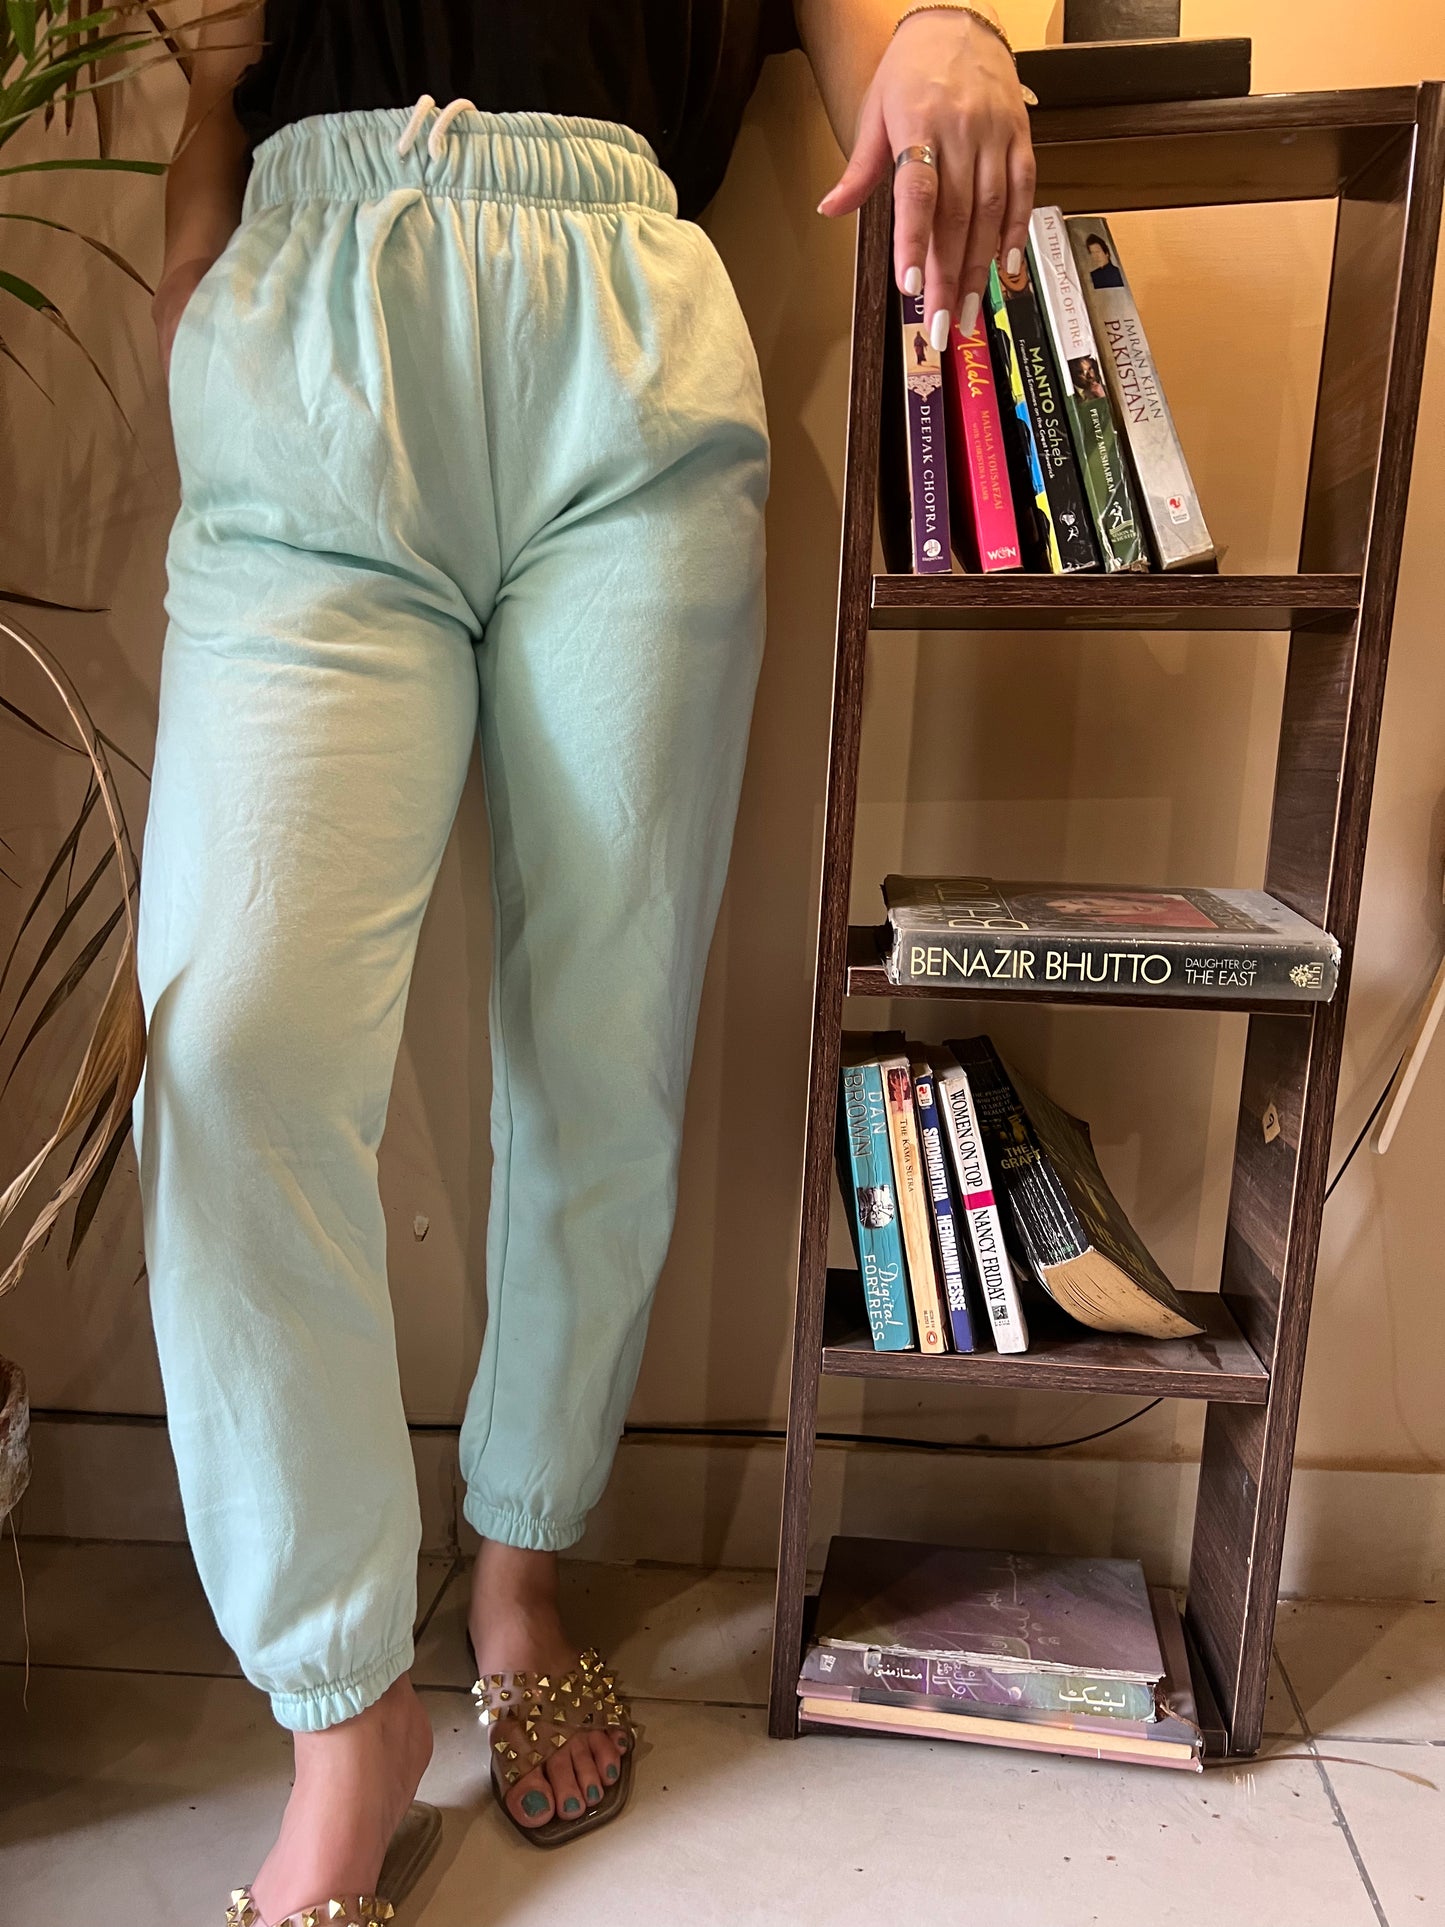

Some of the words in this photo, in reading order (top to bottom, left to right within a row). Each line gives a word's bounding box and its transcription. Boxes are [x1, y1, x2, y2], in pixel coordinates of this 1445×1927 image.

[1044, 216, 1056, 230] IN
[1048, 233, 1062, 261] THE
[1055, 261, 1071, 294] LINE
[1063, 297, 1076, 317] OF
[1068, 317, 1083, 348] FIRE
[1019, 339, 1029, 364] Friends
[1025, 364, 1033, 378] and
[1104, 319, 1150, 424] PAKISTAN
[1123, 318, 1149, 370] IMRAN
[1140, 375, 1165, 419] KHAN
[1027, 378, 1037, 407] Enemies
[1029, 346, 1055, 414] MANTO
[1045, 418, 1068, 467] Saheb
[920, 405, 934, 464] DEEPAK
[981, 410, 994, 450] MALALA
[1039, 429, 1048, 448] Great
[1089, 408, 1102, 442] PERVEZ
[1043, 448, 1055, 479] Maverick
[987, 453, 1004, 510] YOUSAFZAI
[923, 470, 937, 533] CHOPRA
[910, 946, 1036, 980] BENAZIR
[1045, 951, 1172, 984] BHUTTO
[1185, 957, 1240, 970] DAUGHTER
[1241, 960, 1258, 971] OF
[1185, 969, 1214, 985] THE
[1218, 970, 1257, 987] EAST
[844, 1070, 873, 1158] BROWN
[868, 1090, 886, 1135] DAN
[900, 1119, 908, 1136] THE
[950, 1088, 974, 1139] WOMEN
[902, 1139, 912, 1163] KAMA
[923, 1127, 949, 1202] SIDDHARTHA
[959, 1141, 978, 1161] ON
[1001, 1149, 1041, 1169] GRAFT
[1003, 1143, 1030, 1157] THE
[905, 1164, 914, 1193] SUTRA
[963, 1162, 983, 1187] TOP
[936, 1214, 960, 1273] HERMANN
[972, 1209, 997, 1254] NANCY
[874, 1262, 904, 1326] Digital
[946, 1274, 967, 1312] HESSE
[982, 1256, 1006, 1301] FRIDAY
[864, 1254, 885, 1341] FORTRESS
